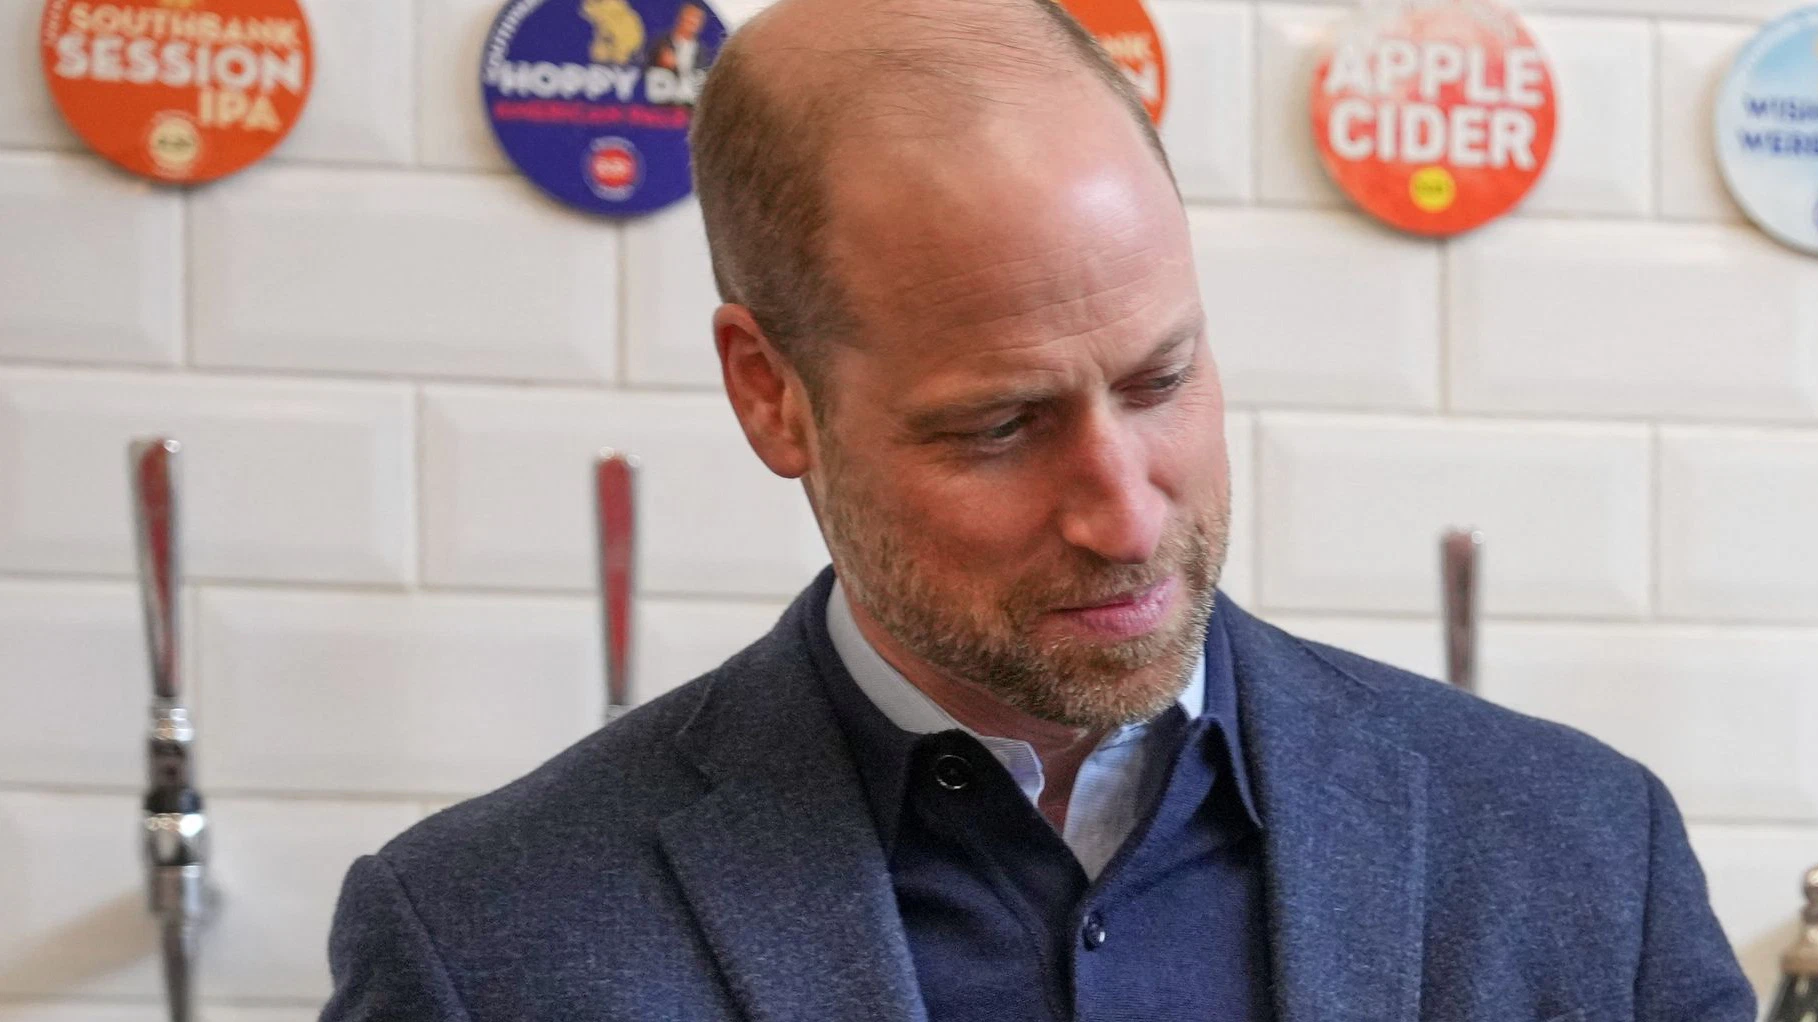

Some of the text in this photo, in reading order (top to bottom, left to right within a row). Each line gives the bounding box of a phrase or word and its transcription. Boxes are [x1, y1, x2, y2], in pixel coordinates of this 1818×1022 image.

[69, 2, 302, 47] SOUTHBANK
[55, 33, 304, 95] SESSION
[498, 61, 640, 101] HOPPY
[1324, 40, 1546, 107] APPLE
[199, 88, 281, 132] IPA
[1328, 98, 1537, 171] CIDER
